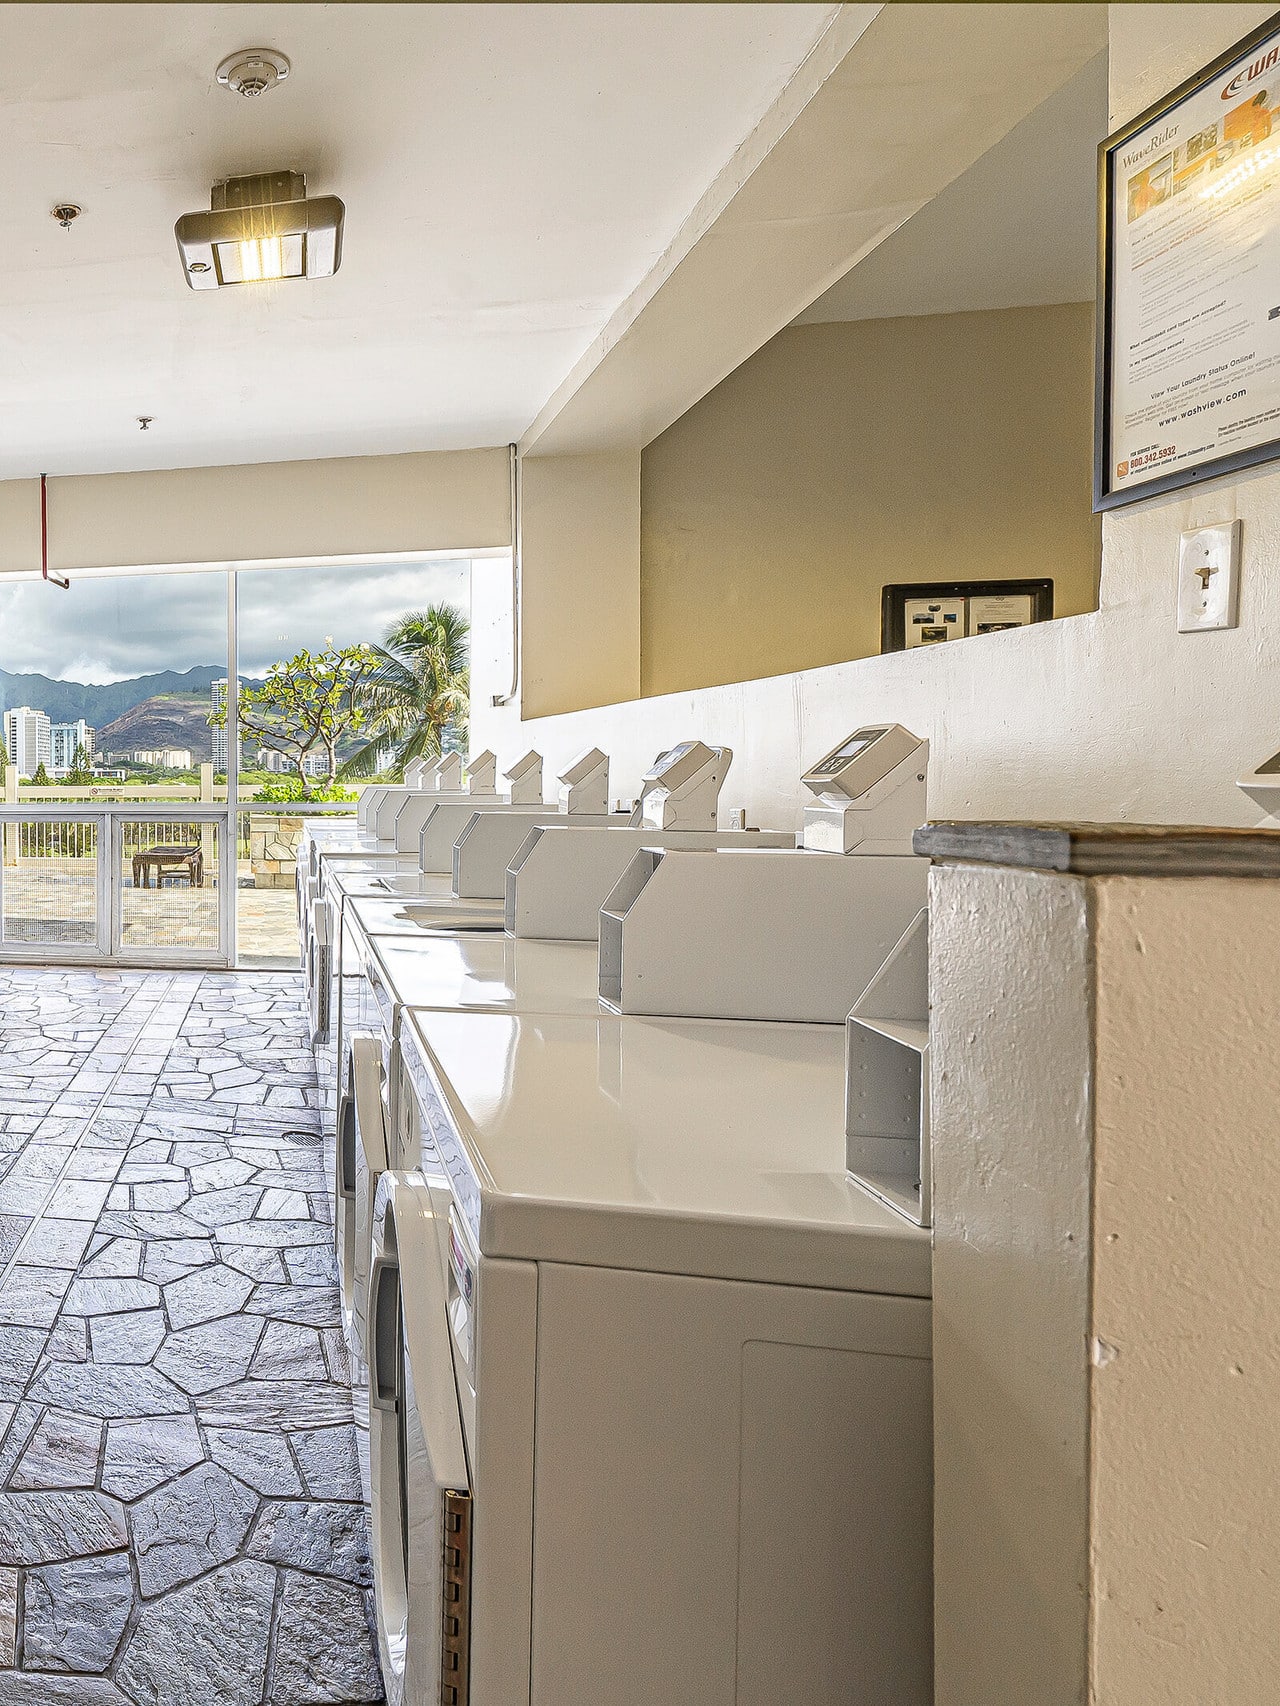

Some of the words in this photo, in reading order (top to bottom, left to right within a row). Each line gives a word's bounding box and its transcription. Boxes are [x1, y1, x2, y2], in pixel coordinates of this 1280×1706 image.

[1248, 45, 1280, 81] WA
[1122, 125, 1180, 168] WaveRider
[1151, 391, 1164, 399] View
[1167, 384, 1180, 392] Your
[1181, 371, 1206, 387] Laundry
[1208, 364, 1228, 376] Status
[1230, 352, 1255, 366] Online!
[1159, 388, 1247, 427] www.washview.com
[1131, 445, 1176, 468] 800.342.5932
